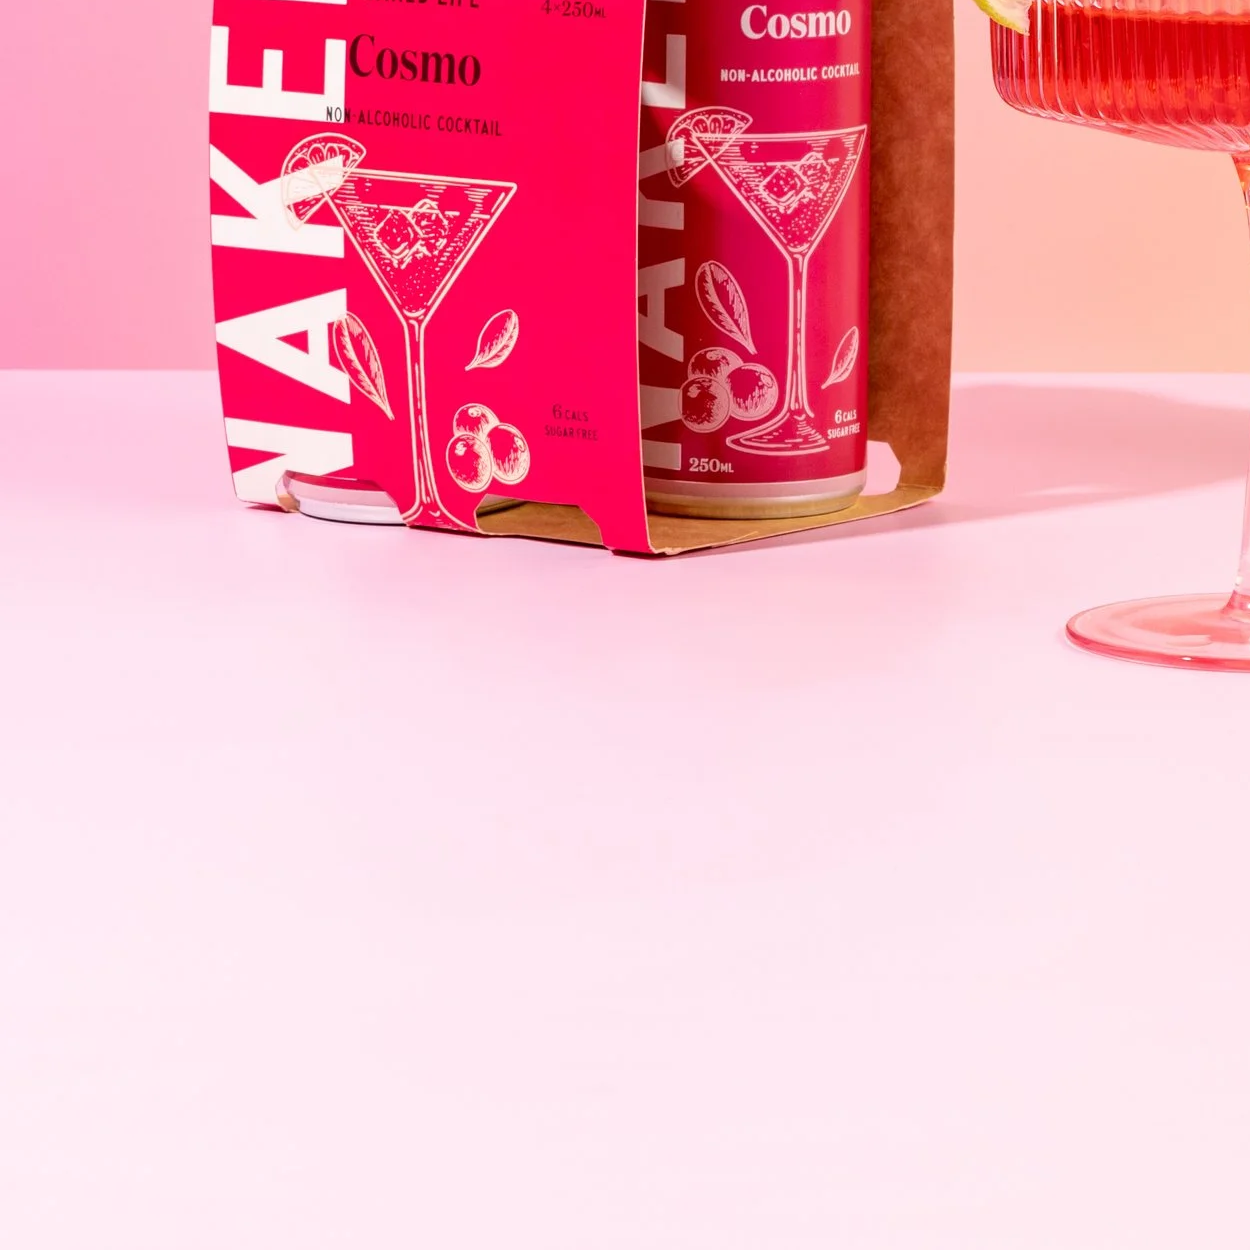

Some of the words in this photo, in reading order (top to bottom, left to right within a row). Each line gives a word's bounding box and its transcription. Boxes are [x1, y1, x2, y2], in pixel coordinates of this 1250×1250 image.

[740, 4, 851, 40] Cosmo
[348, 33, 481, 87] Cosmo
[720, 66, 818, 83] NON-ALCOHOLIC
[821, 62, 860, 79] COCKTAIL
[325, 105, 431, 131] NON-ALCOHOLIC
[436, 115, 502, 137] COCKTAIL
[552, 404, 563, 421] 6
[565, 409, 589, 422] CALS
[834, 409, 842, 424] 6
[843, 409, 857, 422] CALS
[544, 425, 574, 439] SUGAR
[576, 428, 599, 441] FREE
[827, 426, 849, 439] SUGAR
[849, 423, 860, 436] FREE
[689, 457, 734, 473] 250ML
